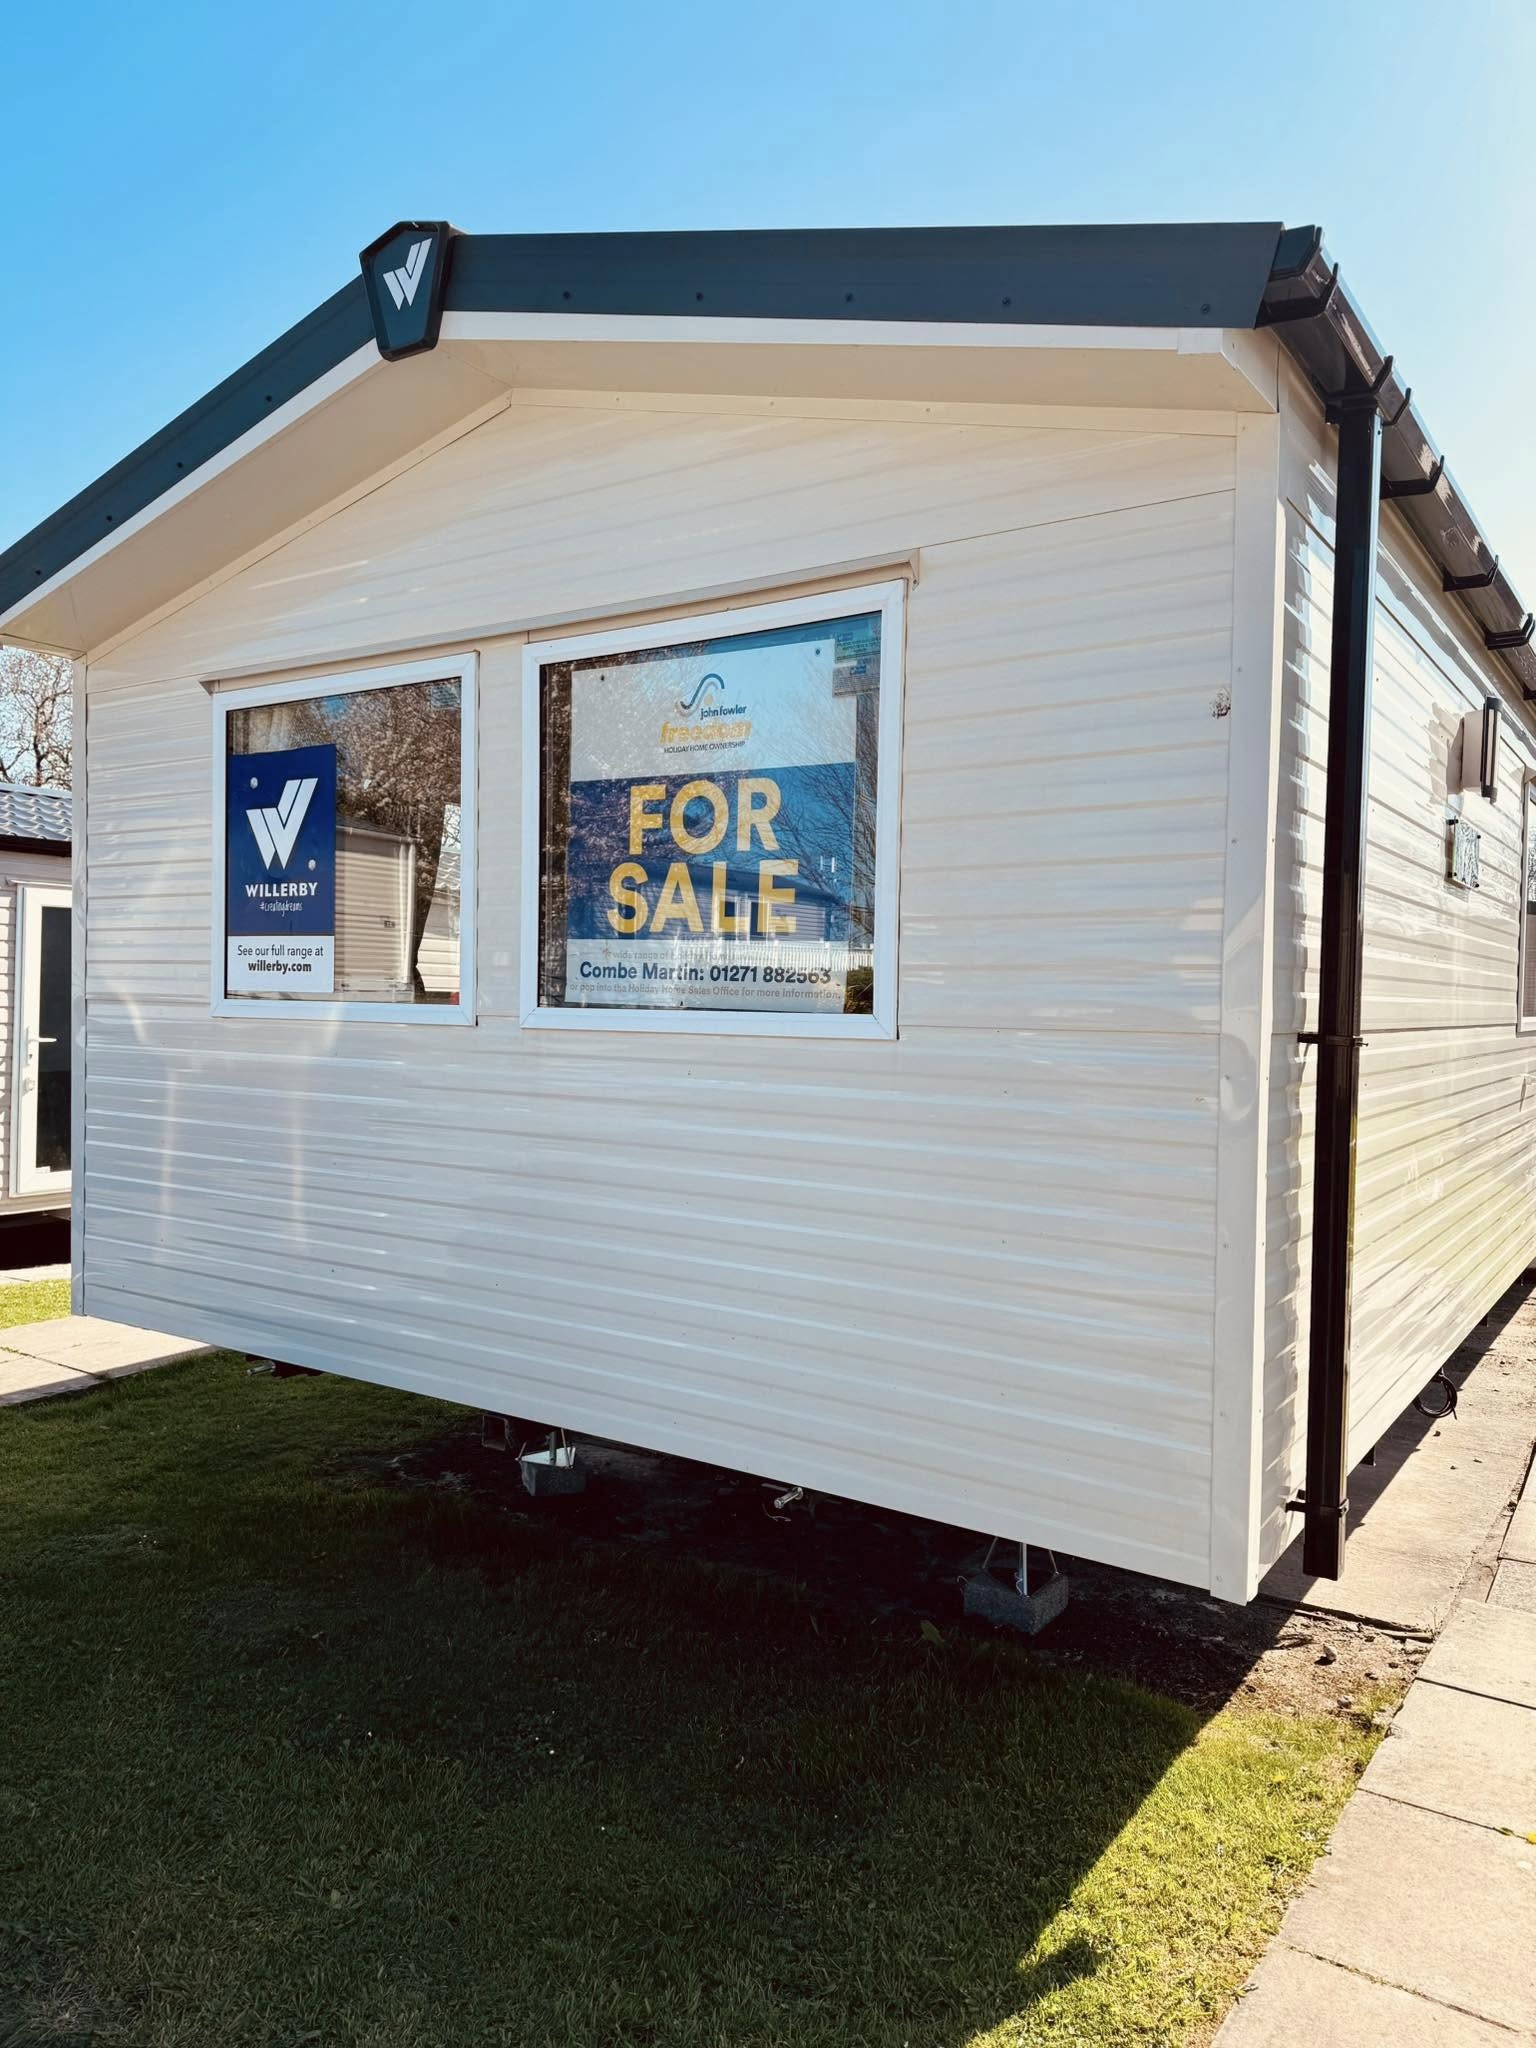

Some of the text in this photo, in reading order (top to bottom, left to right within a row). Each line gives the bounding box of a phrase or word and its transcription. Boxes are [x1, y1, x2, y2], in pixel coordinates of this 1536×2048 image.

[382, 238, 432, 311] W
[700, 704, 747, 720] john fowler
[659, 721, 752, 743] freedom
[664, 740, 746, 754] HOLIDAY HOME OWNERSHIP
[246, 778, 318, 871] W
[629, 777, 782, 856] FOR
[245, 882, 318, 898] WILLERBY
[606, 858, 800, 934] SALE
[237, 944, 324, 959] See our full range at
[248, 960, 312, 975] willerby.com
[580, 961, 832, 984] Combe Martin: 01271 882563
[581, 984, 594, 993] pop
[597, 983, 612, 992] into
[614, 983, 626, 992] the
[628, 984, 658, 994] Holiday
[661, 985, 685, 994] Home
[689, 986, 711, 995] Sales
[713, 986, 739, 997] Office
[742, 987, 754, 996] for
[757, 988, 779, 998] more
[783, 987, 841, 999] information.
